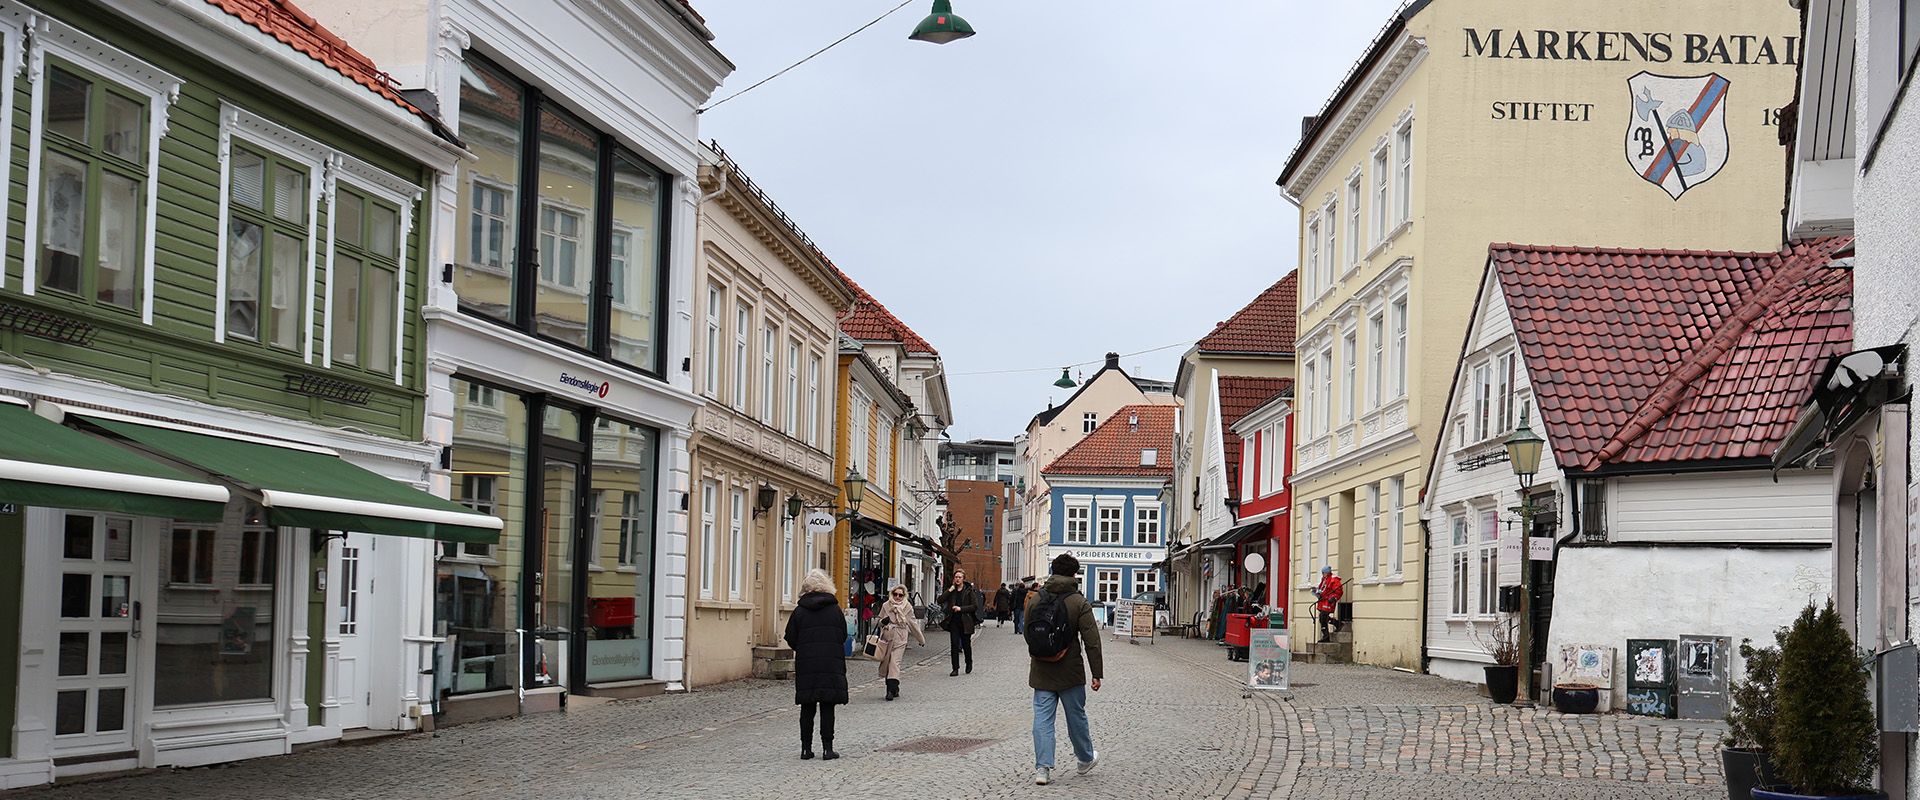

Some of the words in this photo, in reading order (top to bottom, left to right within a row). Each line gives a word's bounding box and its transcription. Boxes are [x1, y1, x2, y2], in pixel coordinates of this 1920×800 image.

[1462, 27, 1673, 63] MARKENS
[1491, 101, 1595, 122] STIFTET
[809, 518, 831, 527] ACEM
[1076, 550, 1142, 559] SPEIDERSENTERET
